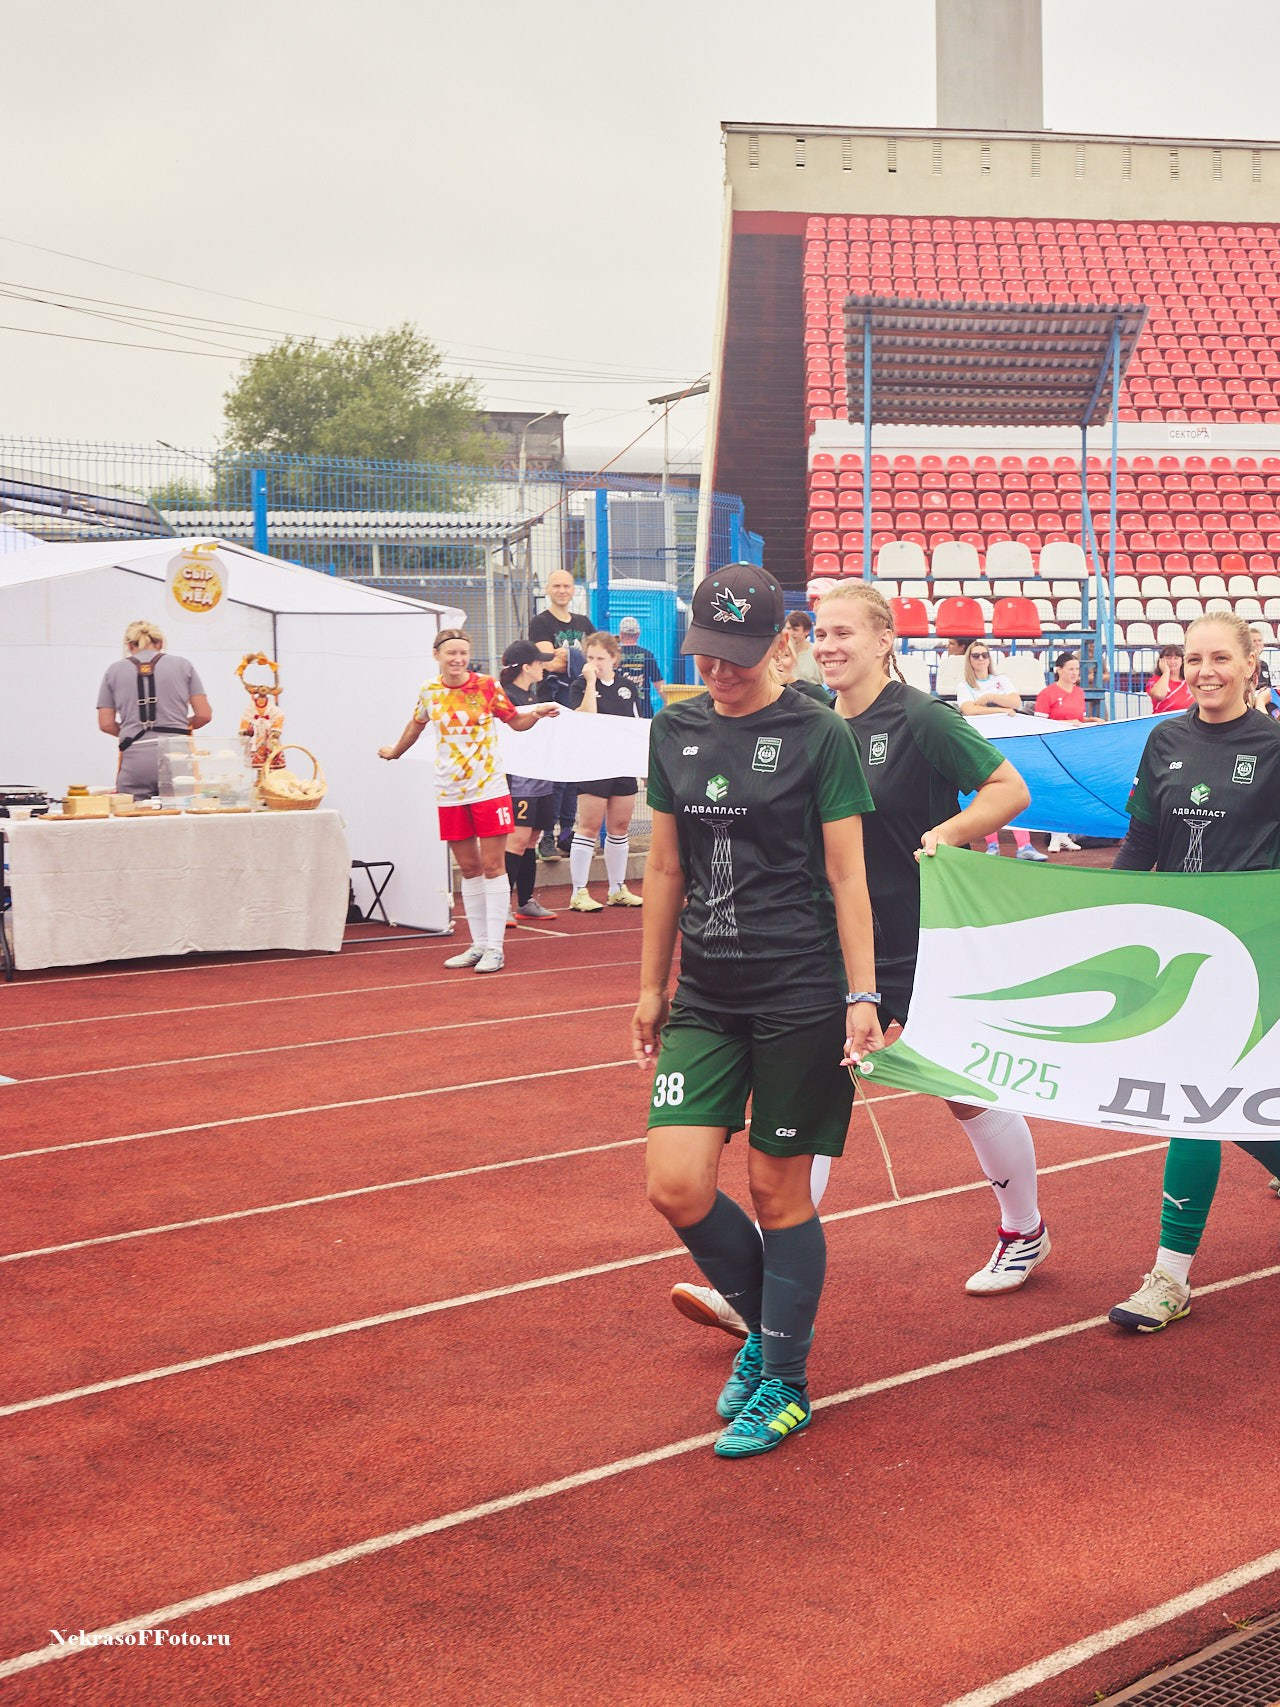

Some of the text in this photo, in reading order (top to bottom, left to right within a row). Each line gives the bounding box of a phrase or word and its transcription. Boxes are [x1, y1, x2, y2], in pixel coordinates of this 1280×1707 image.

[182, 567, 214, 581] СЫР
[682, 746, 699, 756] GS
[1169, 761, 1183, 770] GS
[517, 800, 528, 819] 2
[683, 805, 748, 816] АДВАПЛАСТ
[1172, 808, 1227, 818] АДВАПЛАСТ
[496, 807, 511, 826] 15
[962, 1042, 1063, 1100] 2025
[653, 1072, 685, 1108] 38
[775, 1127, 797, 1137] GS
